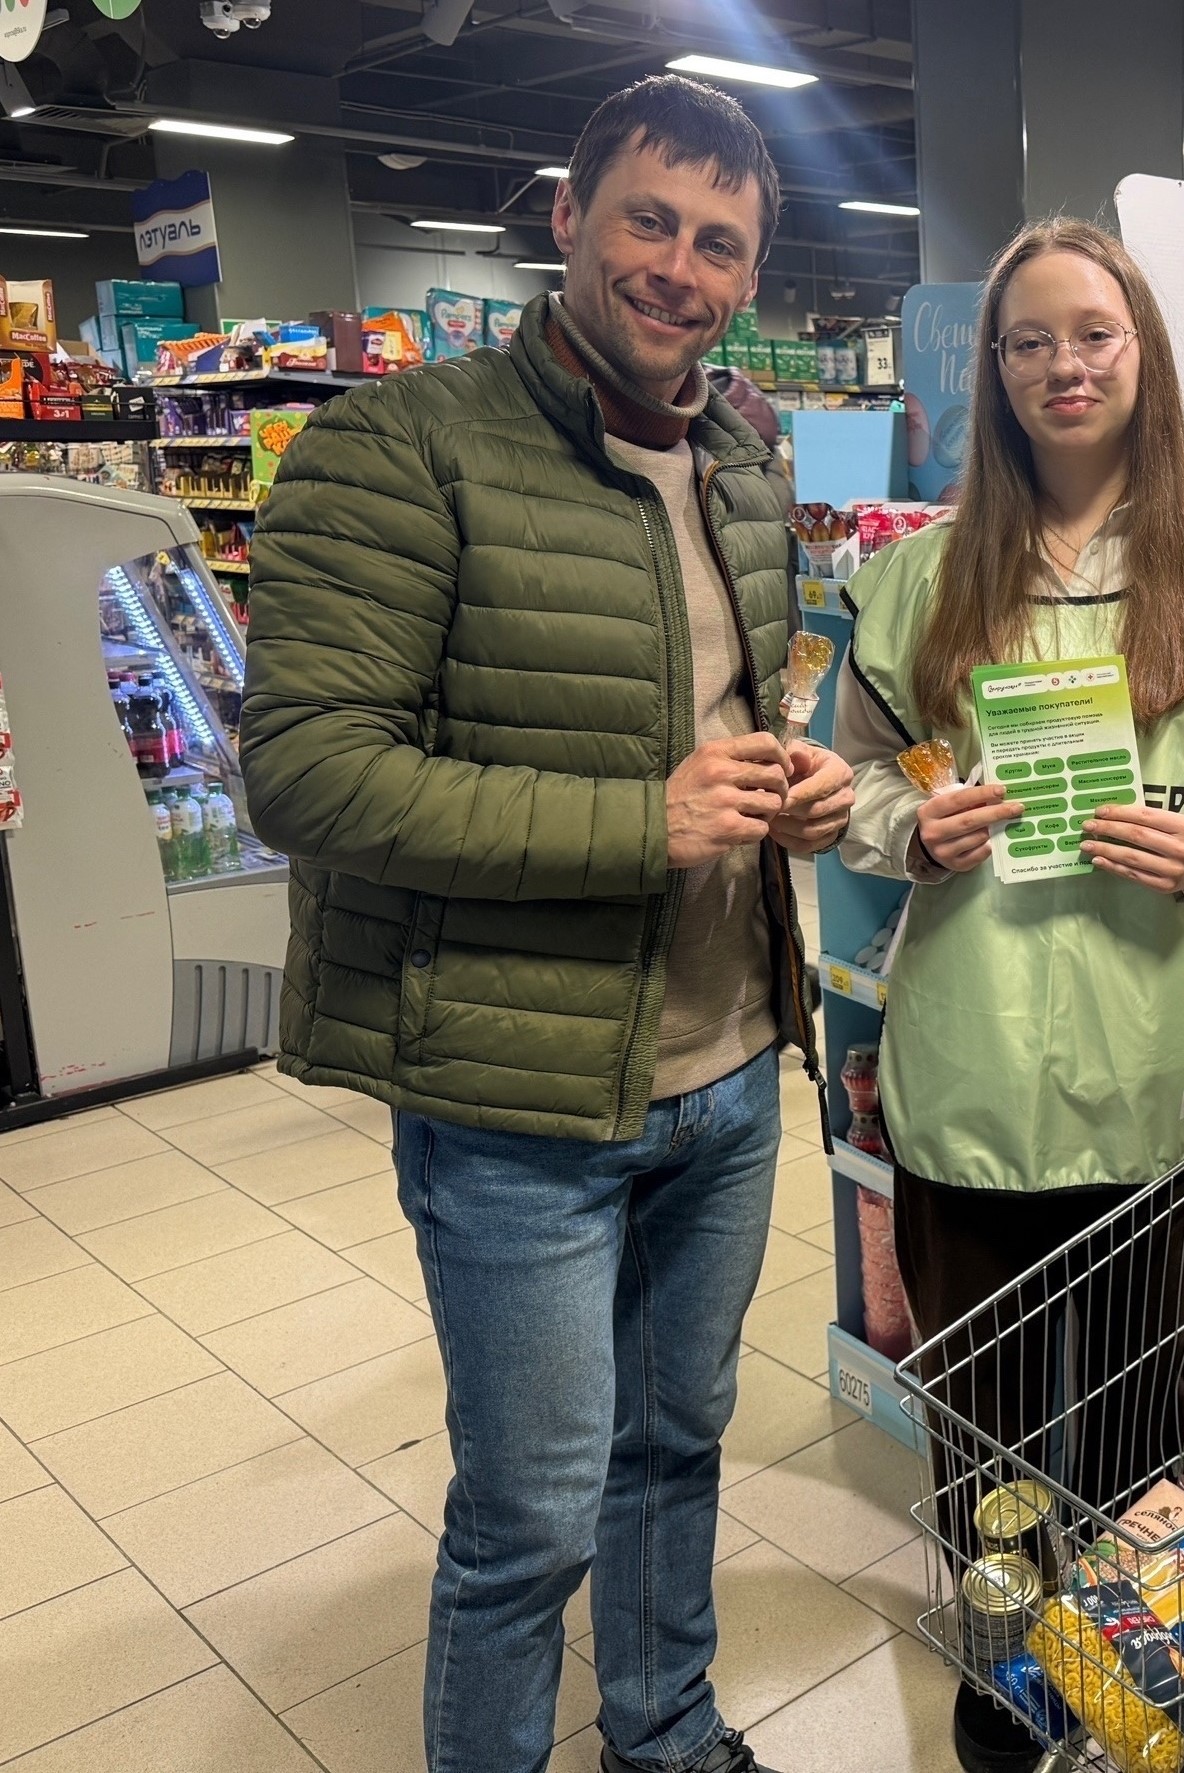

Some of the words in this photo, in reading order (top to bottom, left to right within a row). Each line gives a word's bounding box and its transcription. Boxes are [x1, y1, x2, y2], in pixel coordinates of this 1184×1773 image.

[985, 704, 1037, 717] Уважаемые
[1038, 697, 1094, 713] покупатели!
[1004, 767, 1023, 775] Крупы
[1041, 762, 1056, 770] Мука
[1014, 843, 1048, 853] Сухофрукты
[1011, 866, 1039, 874] Спасибо
[1048, 862, 1073, 870] участие
[839, 1368, 870, 1407] 60275
